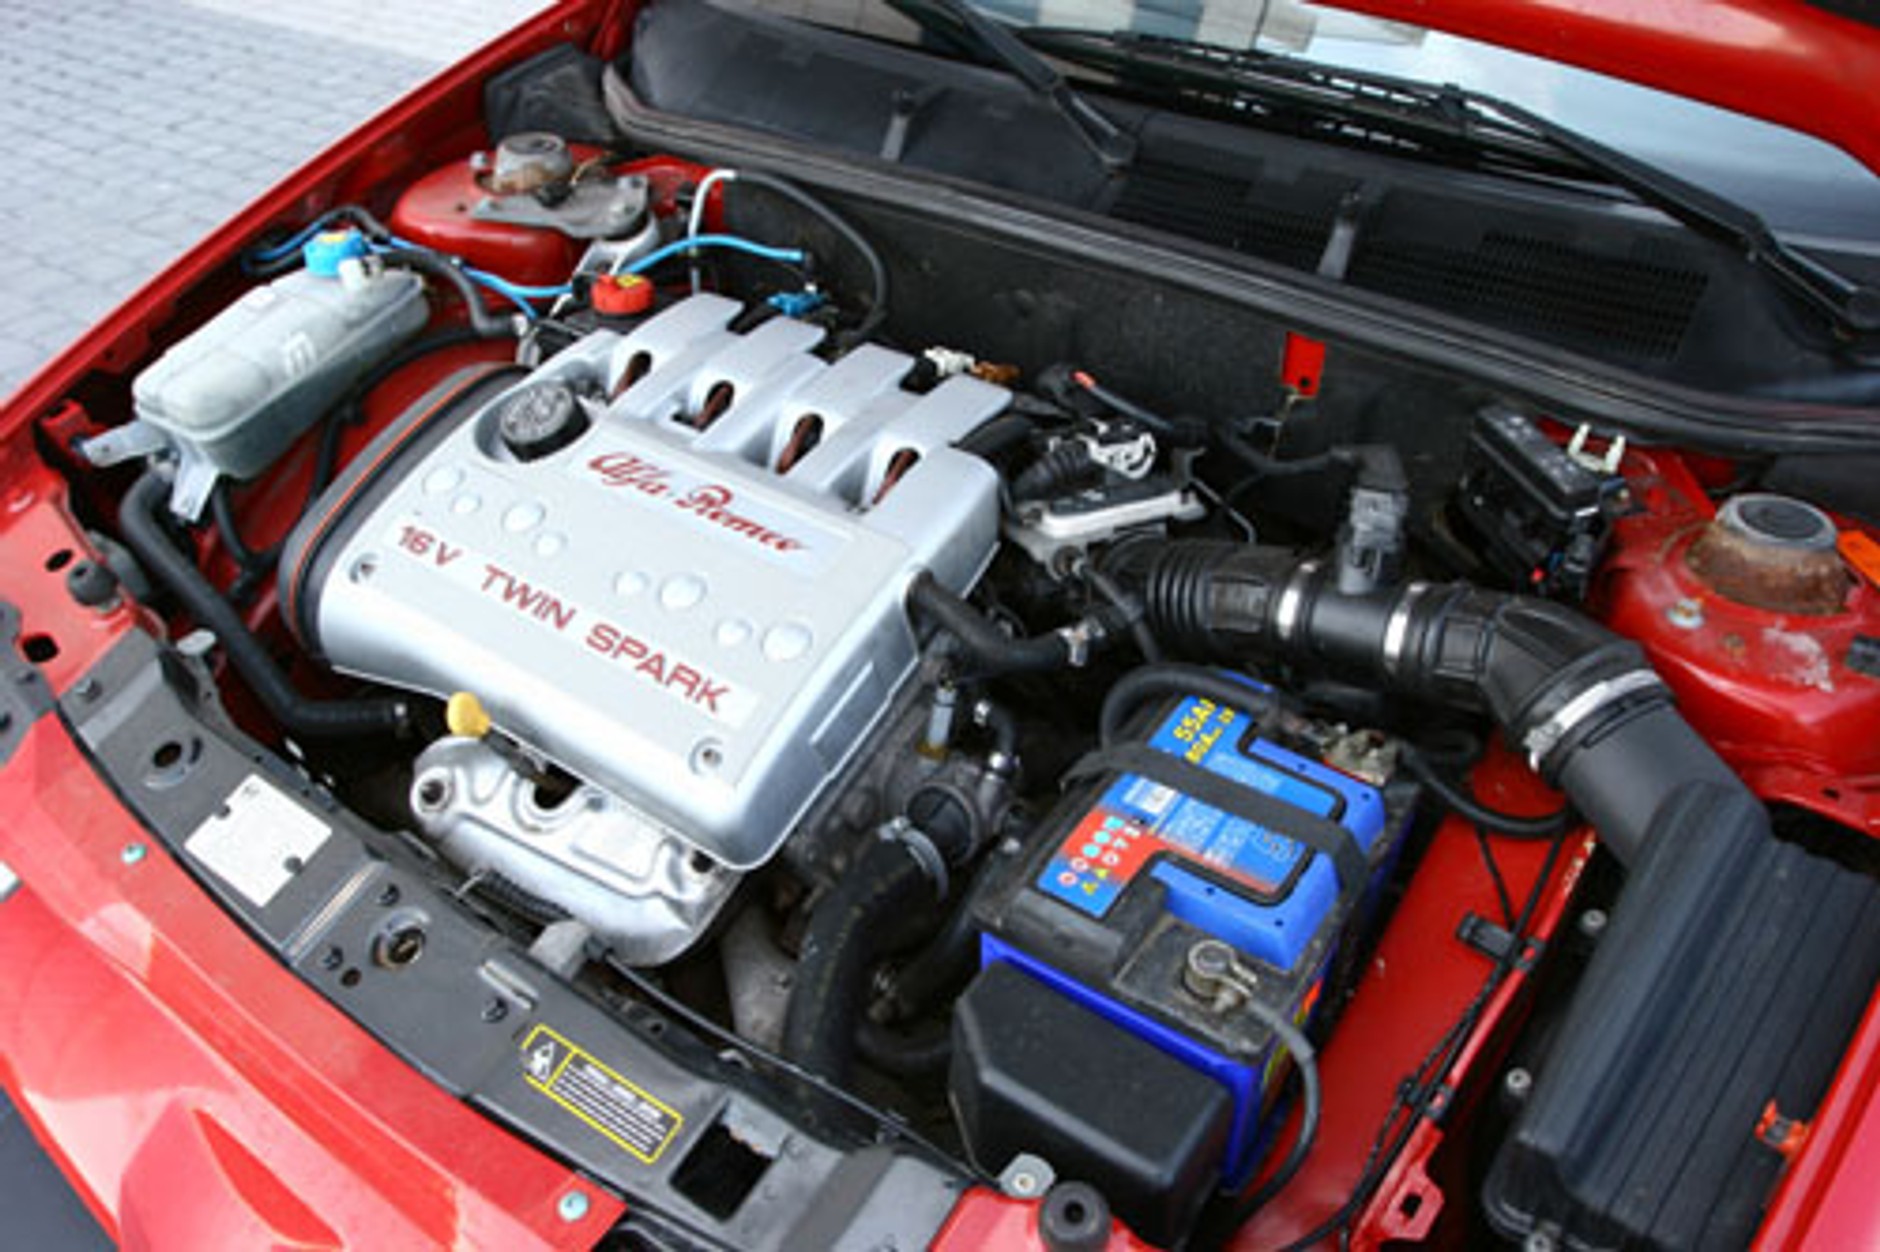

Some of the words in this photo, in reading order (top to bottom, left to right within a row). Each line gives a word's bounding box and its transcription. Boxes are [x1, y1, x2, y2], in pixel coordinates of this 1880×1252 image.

[587, 451, 672, 496] Alfa
[673, 484, 805, 552] Romeo
[397, 525, 463, 568] 16V
[481, 564, 576, 631] TWIN
[586, 623, 734, 713] SPARK
